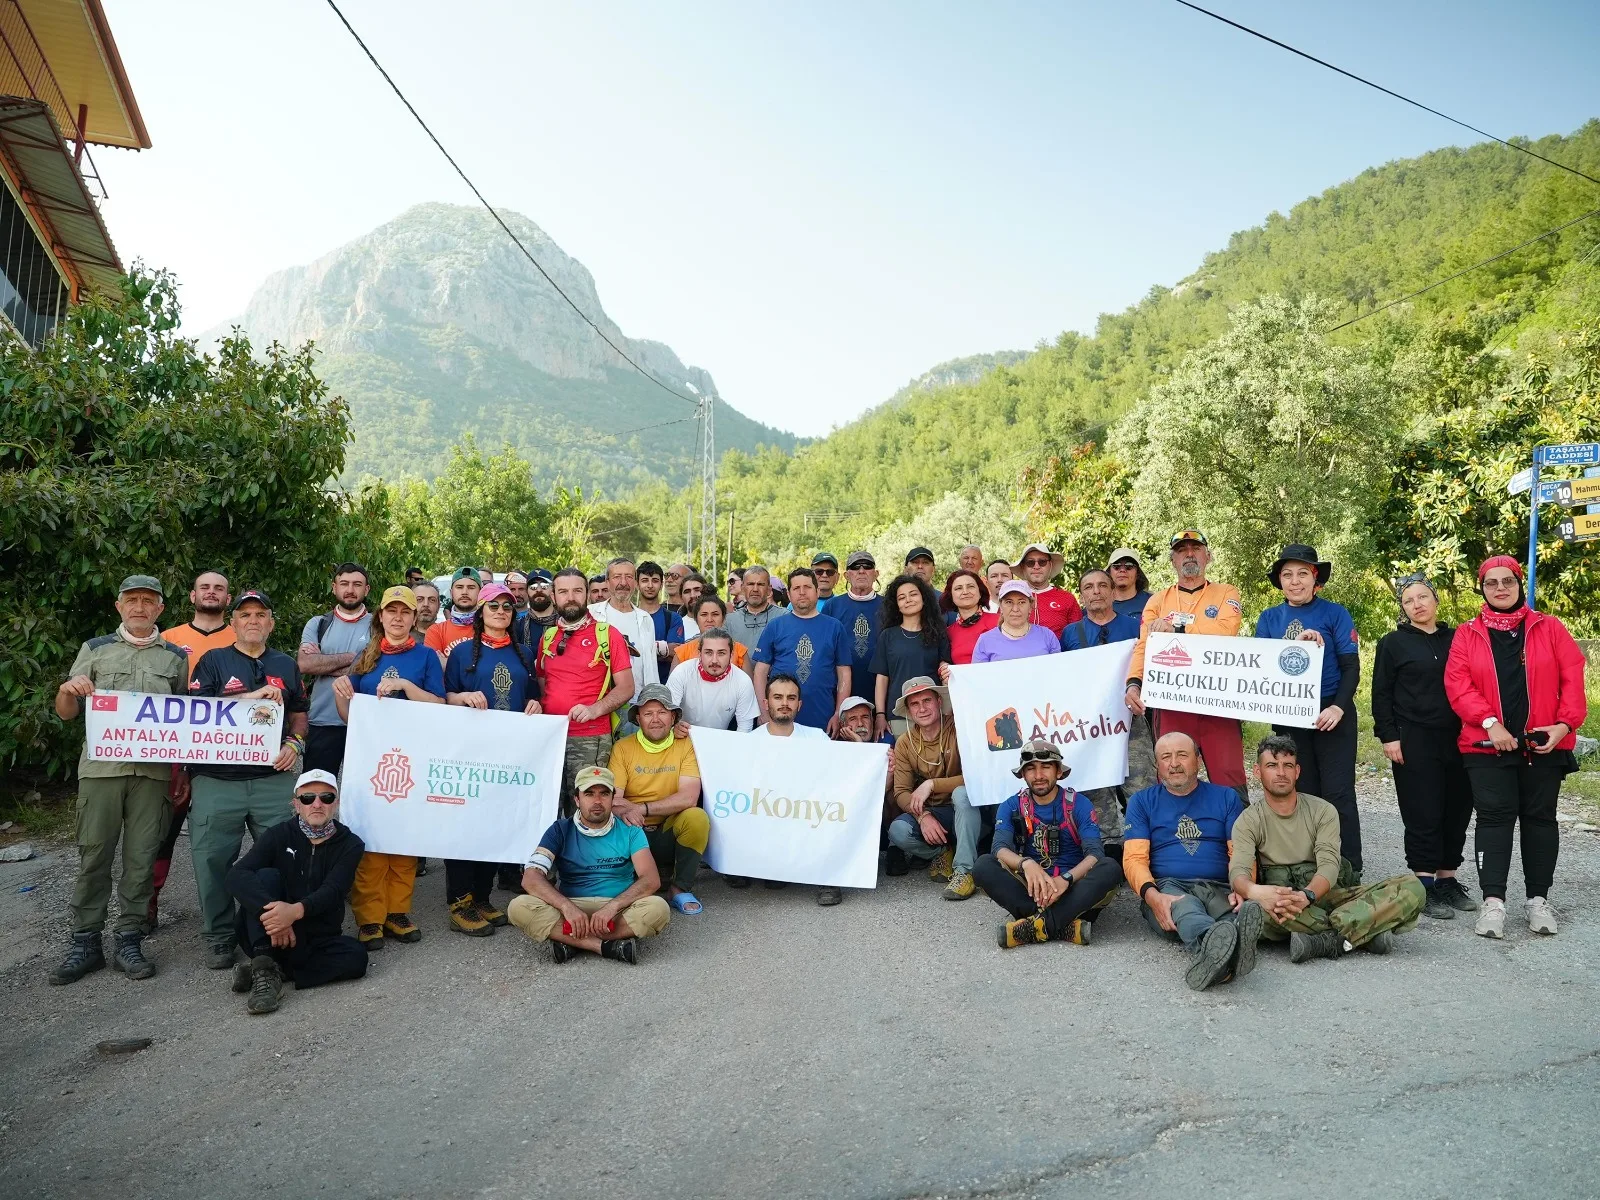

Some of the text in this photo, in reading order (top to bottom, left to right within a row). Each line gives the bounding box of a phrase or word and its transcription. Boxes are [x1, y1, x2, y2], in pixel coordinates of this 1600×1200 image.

[1549, 451, 1593, 459] CADDESİ
[1557, 487, 1571, 499] 10
[1560, 522, 1573, 534] 18
[1202, 650, 1262, 669] SEDAK
[1147, 669, 1316, 699] SELÇUKLU DAĞCILIK
[134, 696, 239, 727] ADDK
[1148, 690, 1314, 717] ve ARAMA KURTARMA SPOR KULÜBÜ
[1033, 702, 1075, 728] Via
[102, 728, 265, 747] ANTALYA DAĞCILIK
[1028, 714, 1128, 746] Anatolia
[95, 744, 270, 762] DOĞA SPORLARI KULÜBÜ
[429, 758, 463, 766] KEYKUBAD
[465, 761, 500, 769] MIGRATION
[643, 765, 676, 774] Columbia
[428, 764, 536, 786] KEYKUBAD
[427, 779, 480, 798] YOLU
[712, 787, 848, 829] goKonya
